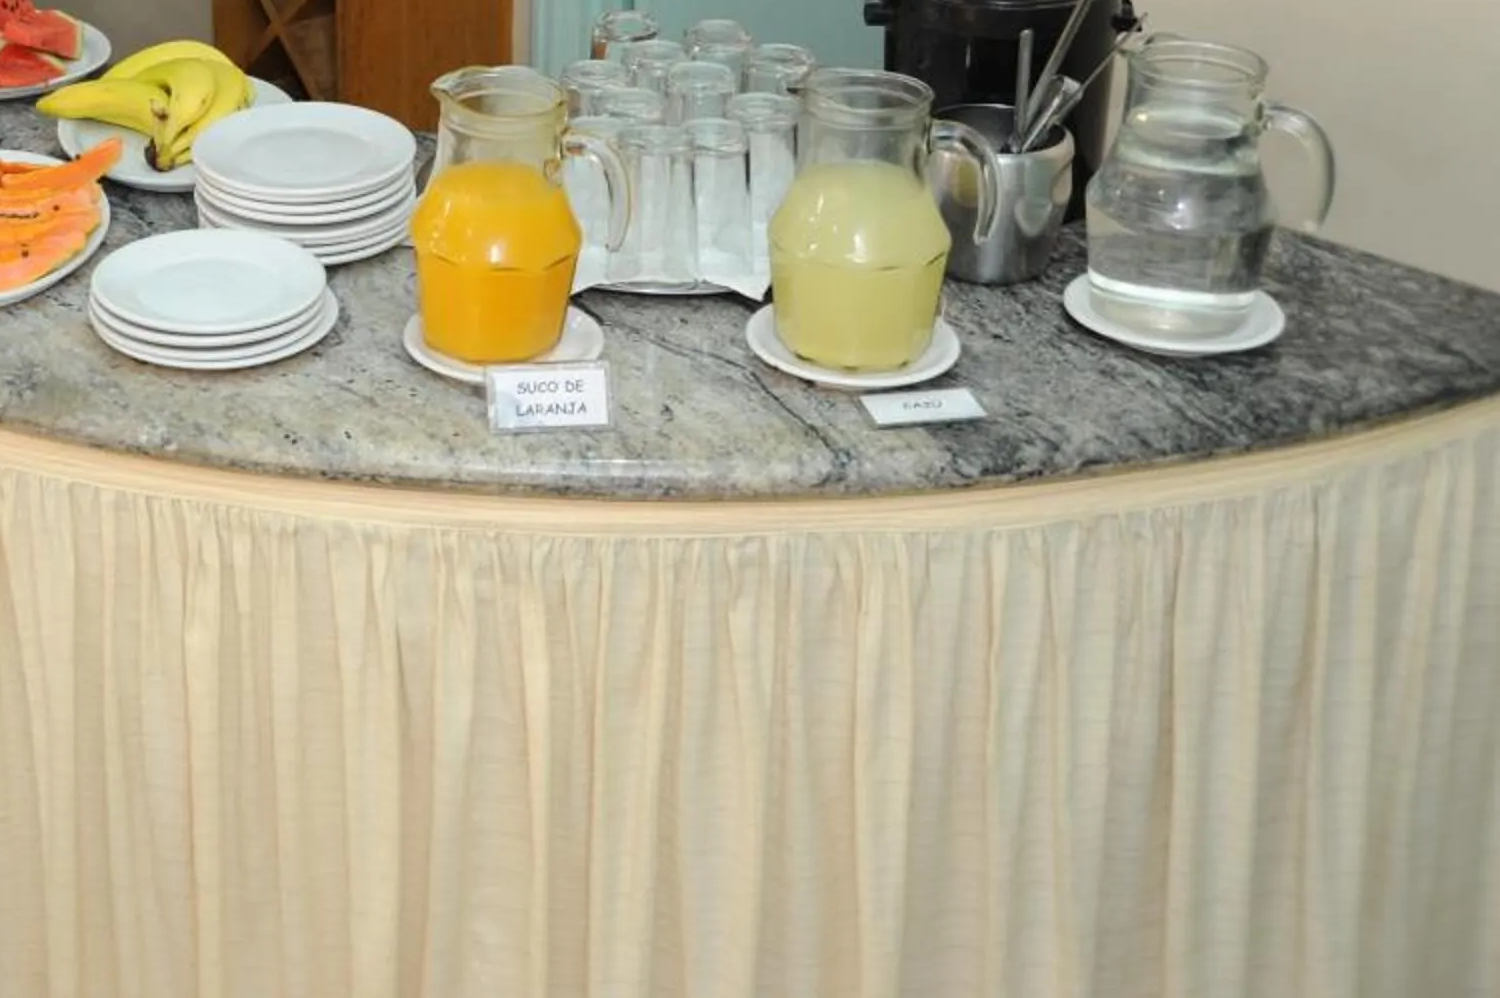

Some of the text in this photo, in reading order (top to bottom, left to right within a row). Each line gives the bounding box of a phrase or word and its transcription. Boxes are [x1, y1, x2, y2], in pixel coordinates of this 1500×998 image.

[517, 379, 585, 395] SUCO DE
[515, 401, 587, 417] LARANJA
